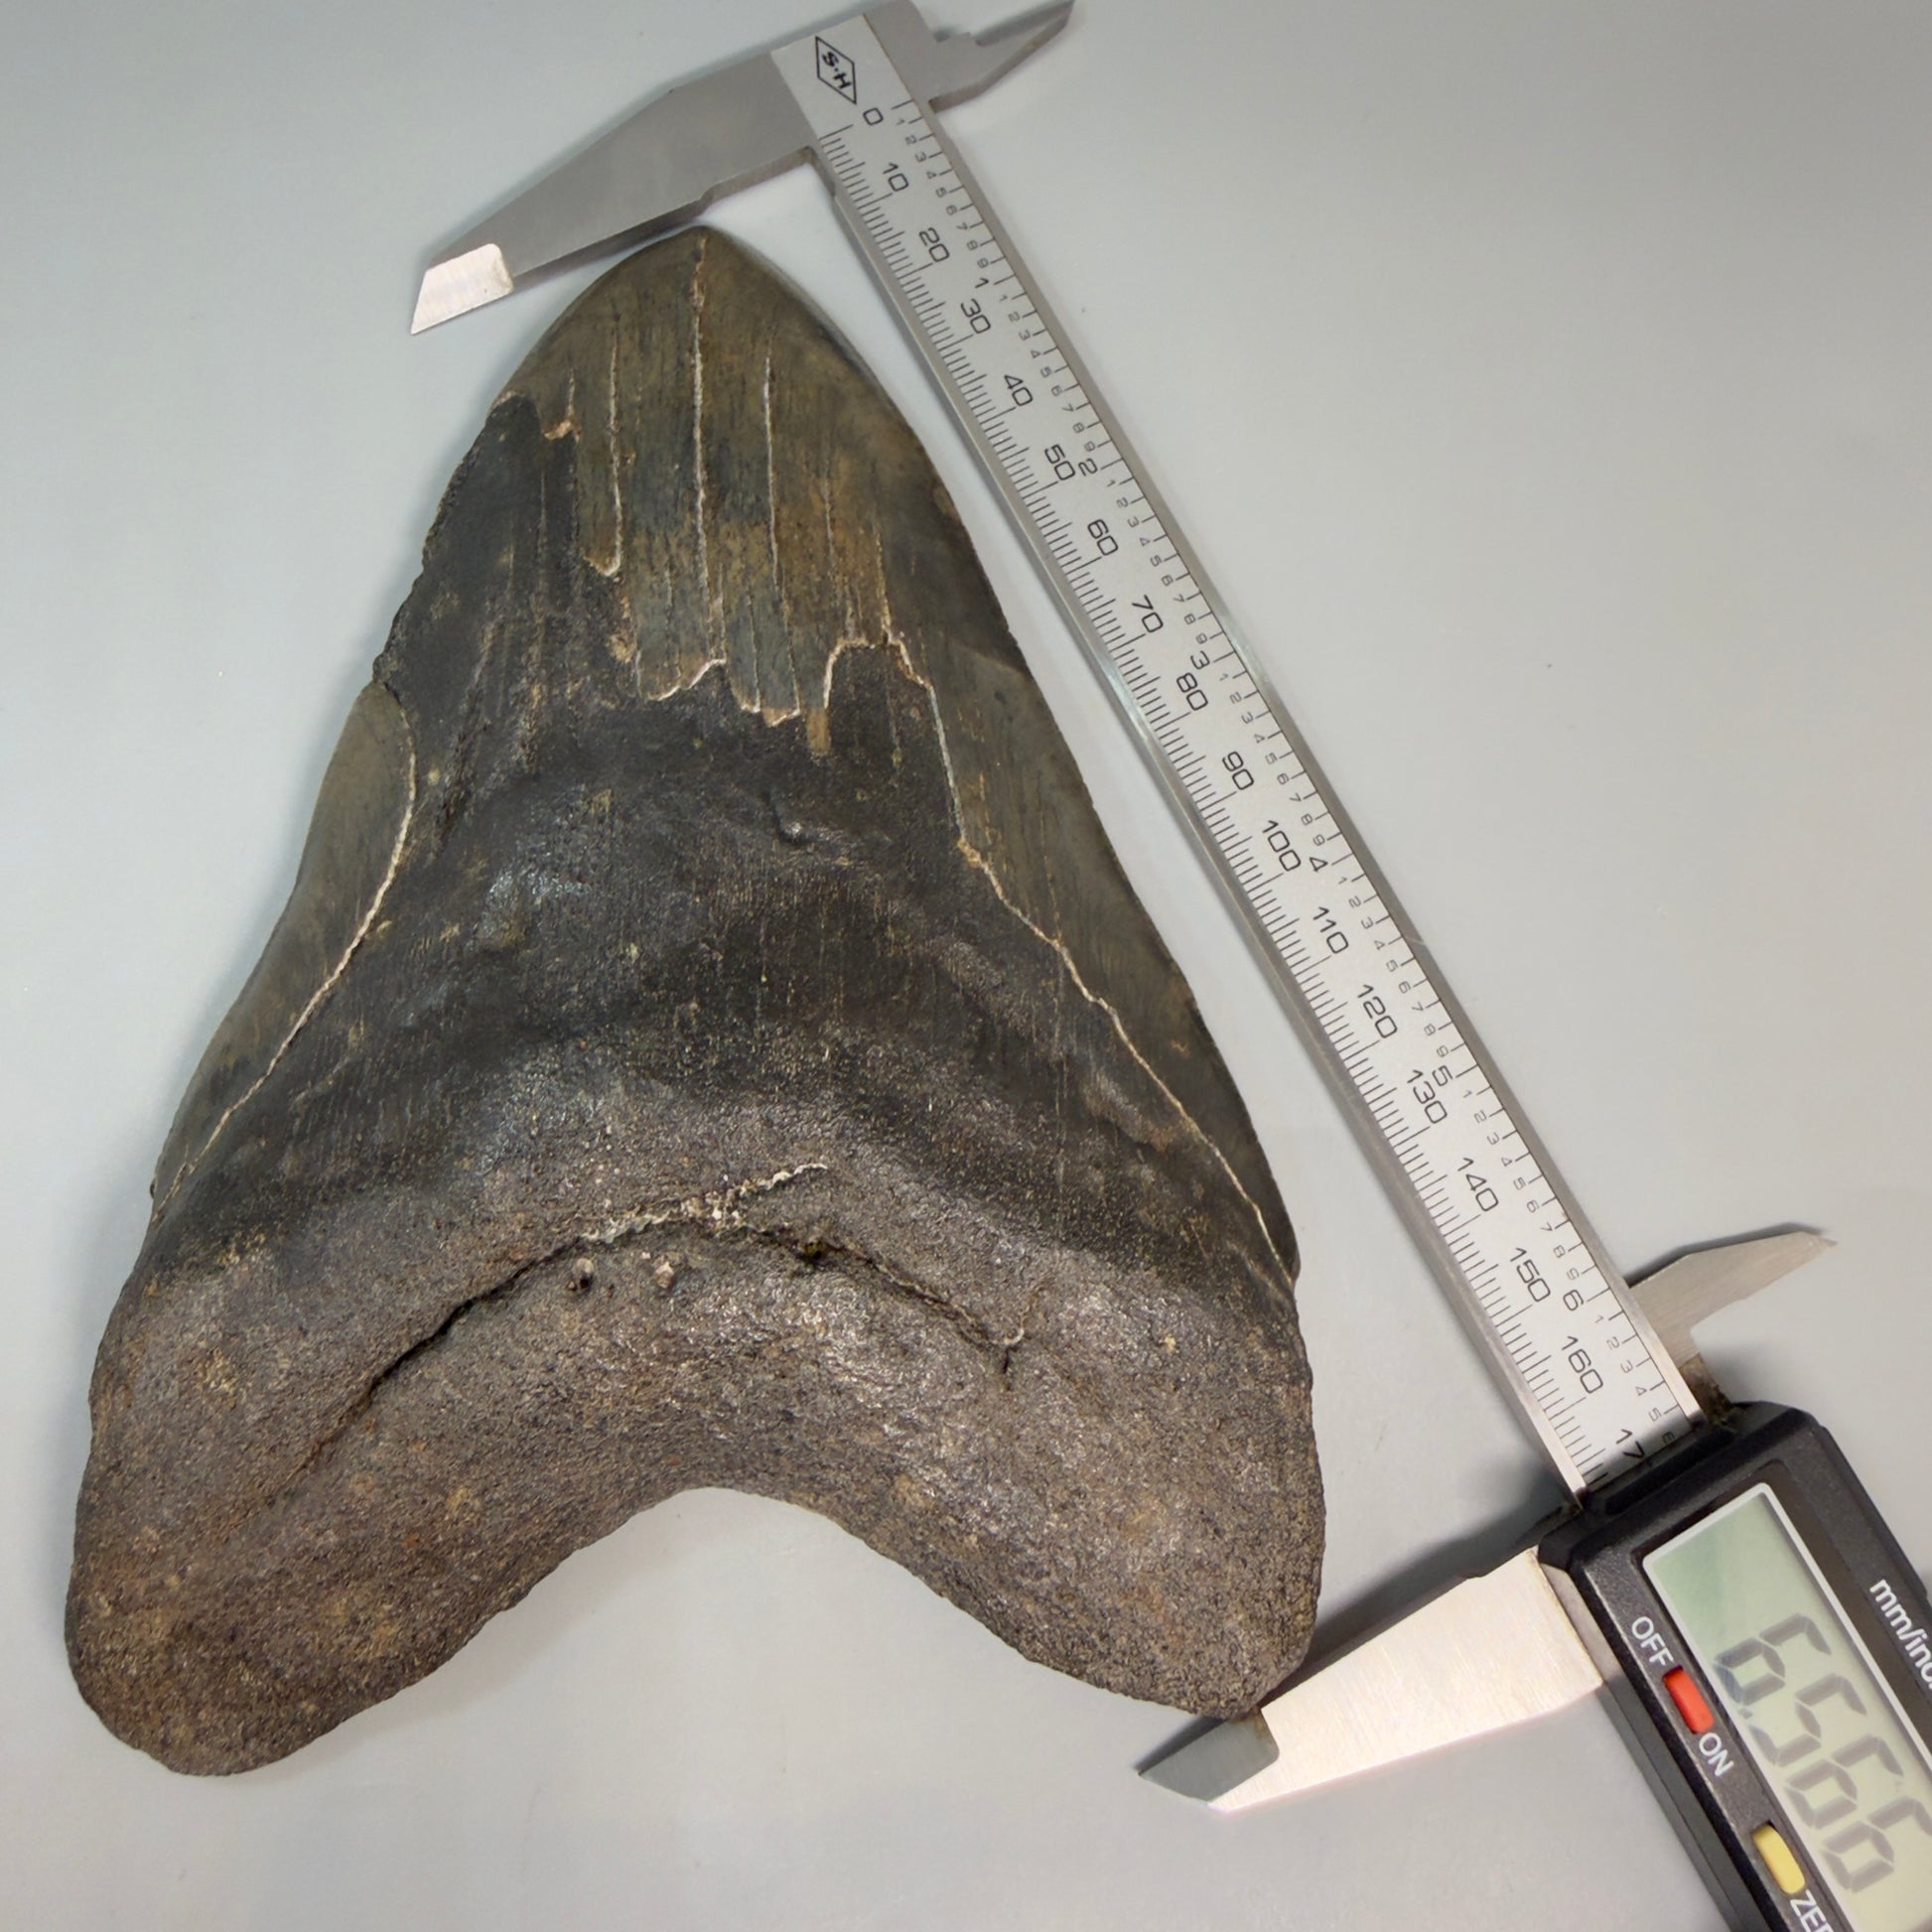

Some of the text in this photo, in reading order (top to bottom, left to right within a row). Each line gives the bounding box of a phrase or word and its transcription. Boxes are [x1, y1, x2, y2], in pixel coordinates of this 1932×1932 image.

[905, 135, 916, 145] 2
[915, 152, 926, 162] 3
[936, 187, 946, 198] 5
[946, 205, 957, 214] 6
[966, 240, 978, 250] 8
[977, 258, 988, 268] 9
[975, 278, 989, 289] 1
[1008, 312, 1020, 322] 2
[1019, 330, 1031, 341] 3
[1031, 349, 1040, 358] 4
[1040, 366, 1051, 377] 5
[1051, 386, 1062, 396] 6
[1062, 403, 1073, 413] 7
[1073, 423, 1084, 433] 8
[1084, 442, 1095, 452] 9
[1078, 459, 1097, 477] 2
[1116, 497, 1128, 507] 2
[1128, 516, 1139, 528] 3
[1140, 537, 1150, 546] 4
[1150, 556, 1162, 567] 5
[1162, 575, 1173, 586] 6
[1173, 594, 1184, 603] 7
[1184, 614, 1195, 624] 8
[1195, 633, 1207, 644] 9
[1190, 651, 1210, 669] 3
[1230, 692, 1241, 704] 2
[1241, 712, 1253, 724] 3
[1254, 734, 1265, 744] 4
[863, 108, 883, 125] 0
[883, 163, 908, 192] 10
[919, 227, 950, 262] 20
[960, 299, 991, 334] 30
[1004, 374, 1033, 406] 40
[1044, 445, 1075, 481] 50
[1087, 519, 1118, 556] 60
[1132, 595, 1163, 632] 70
[1176, 673, 1208, 710] 80
[1222, 752, 1254, 790] 90
[1263, 820, 1301, 872] 100
[1313, 906, 1348, 953] 110
[1357, 985, 1397, 1037] 120
[1407, 1069, 1448, 1123] 130
[1457, 1158, 1498, 1211] 140
[1510, 1248, 1551, 1302] 150
[1562, 1335, 1603, 1394] 160
[1265, 753, 1278, 764] 5
[1277, 773, 1289, 784] 6
[1289, 793, 1301, 803] 7
[1301, 814, 1312, 825] 8
[1312, 834, 1324, 846] 9
[1309, 857, 1328, 872] 4
[1348, 897, 1361, 907] 2
[1361, 917, 1373, 929] 3
[1374, 940, 1385, 950] 4
[1386, 960, 1398, 972] 5
[1399, 981, 1411, 993] 6
[1412, 1002, 1424, 1013] 7
[1424, 1024, 1436, 1035] 8
[1437, 1046, 1449, 1057] 9
[1433, 1065, 1452, 1086] 5
[1474, 1111, 1486, 1124] 2
[1487, 1133, 1499, 1145] 3
[1501, 1157, 1512, 1167] 4
[1514, 1177, 1526, 1190] 5
[1527, 1200, 1539, 1213] 6
[1541, 1222, 1553, 1232] 7
[1553, 1245, 1566, 1258] 8
[1567, 1268, 1579, 1280] 9
[1563, 1290, 1584, 1311] 6
[1606, 1336, 1619, 1349] 2
[1620, 1360, 1633, 1373] 3
[1636, 1386, 1647, 1396] 4
[1648, 1408, 1661, 1422] 5
[1869, 1580, 1932, 1690] mm/inc
[1631, 1616, 1675, 1666] OFF
[1699, 1732, 1734, 1776] ON
